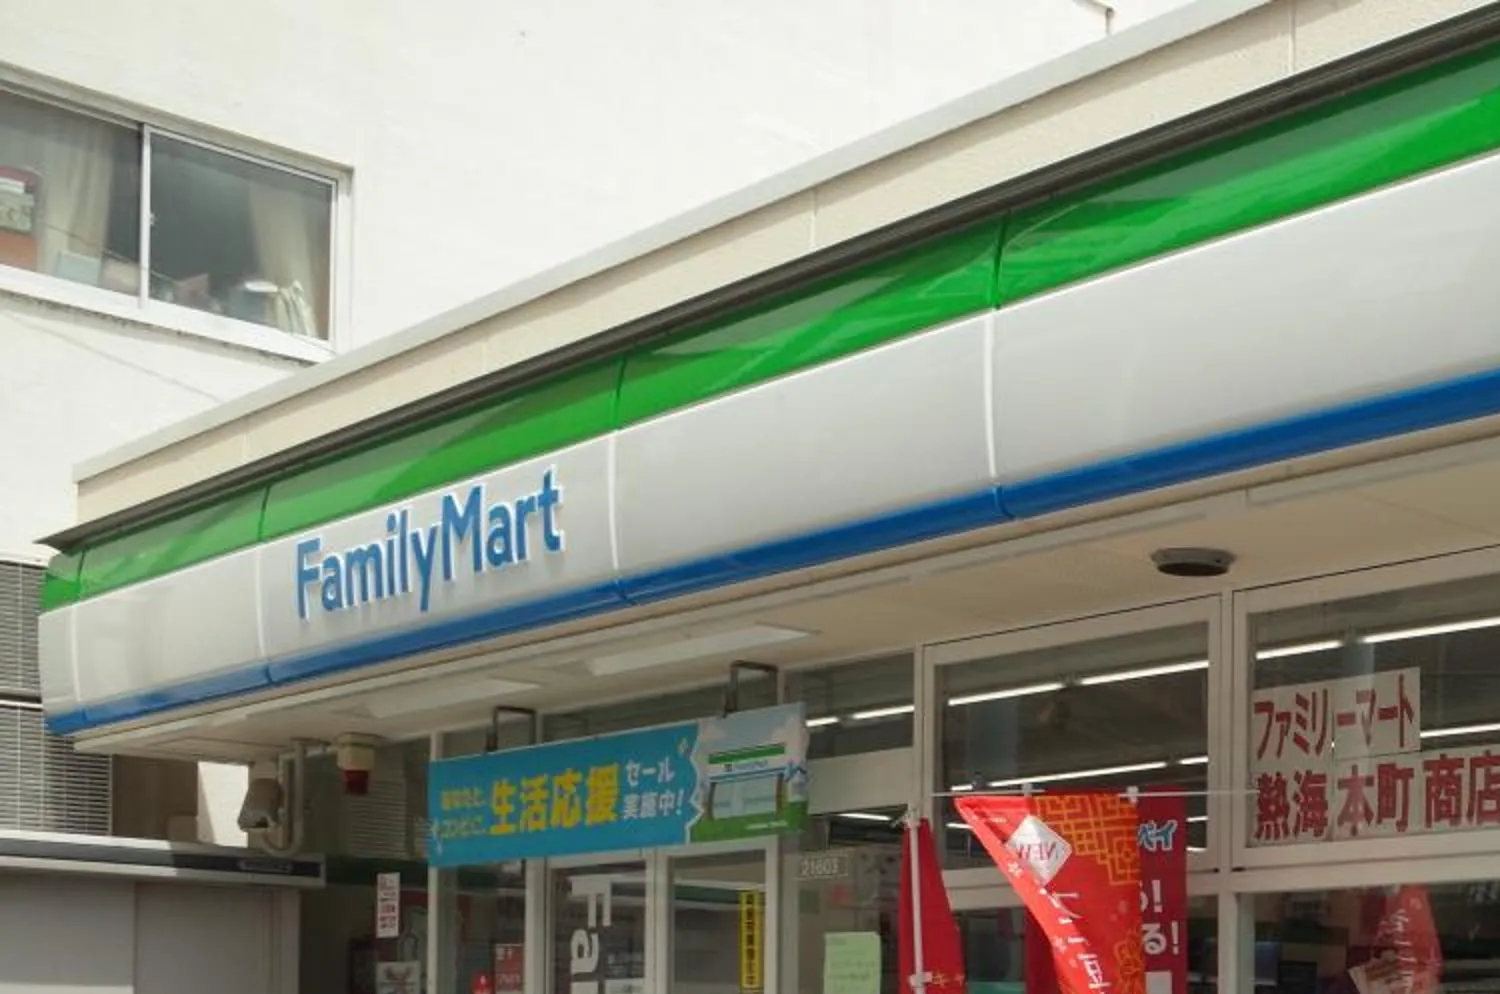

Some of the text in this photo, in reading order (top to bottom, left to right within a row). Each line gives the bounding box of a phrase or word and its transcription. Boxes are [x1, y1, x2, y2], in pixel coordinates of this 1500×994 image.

[296, 468, 562, 620] FamilyMart
[1254, 673, 1413, 760] ファミリーマート
[490, 762, 620, 836] 生活応援
[625, 759, 676, 787] セール
